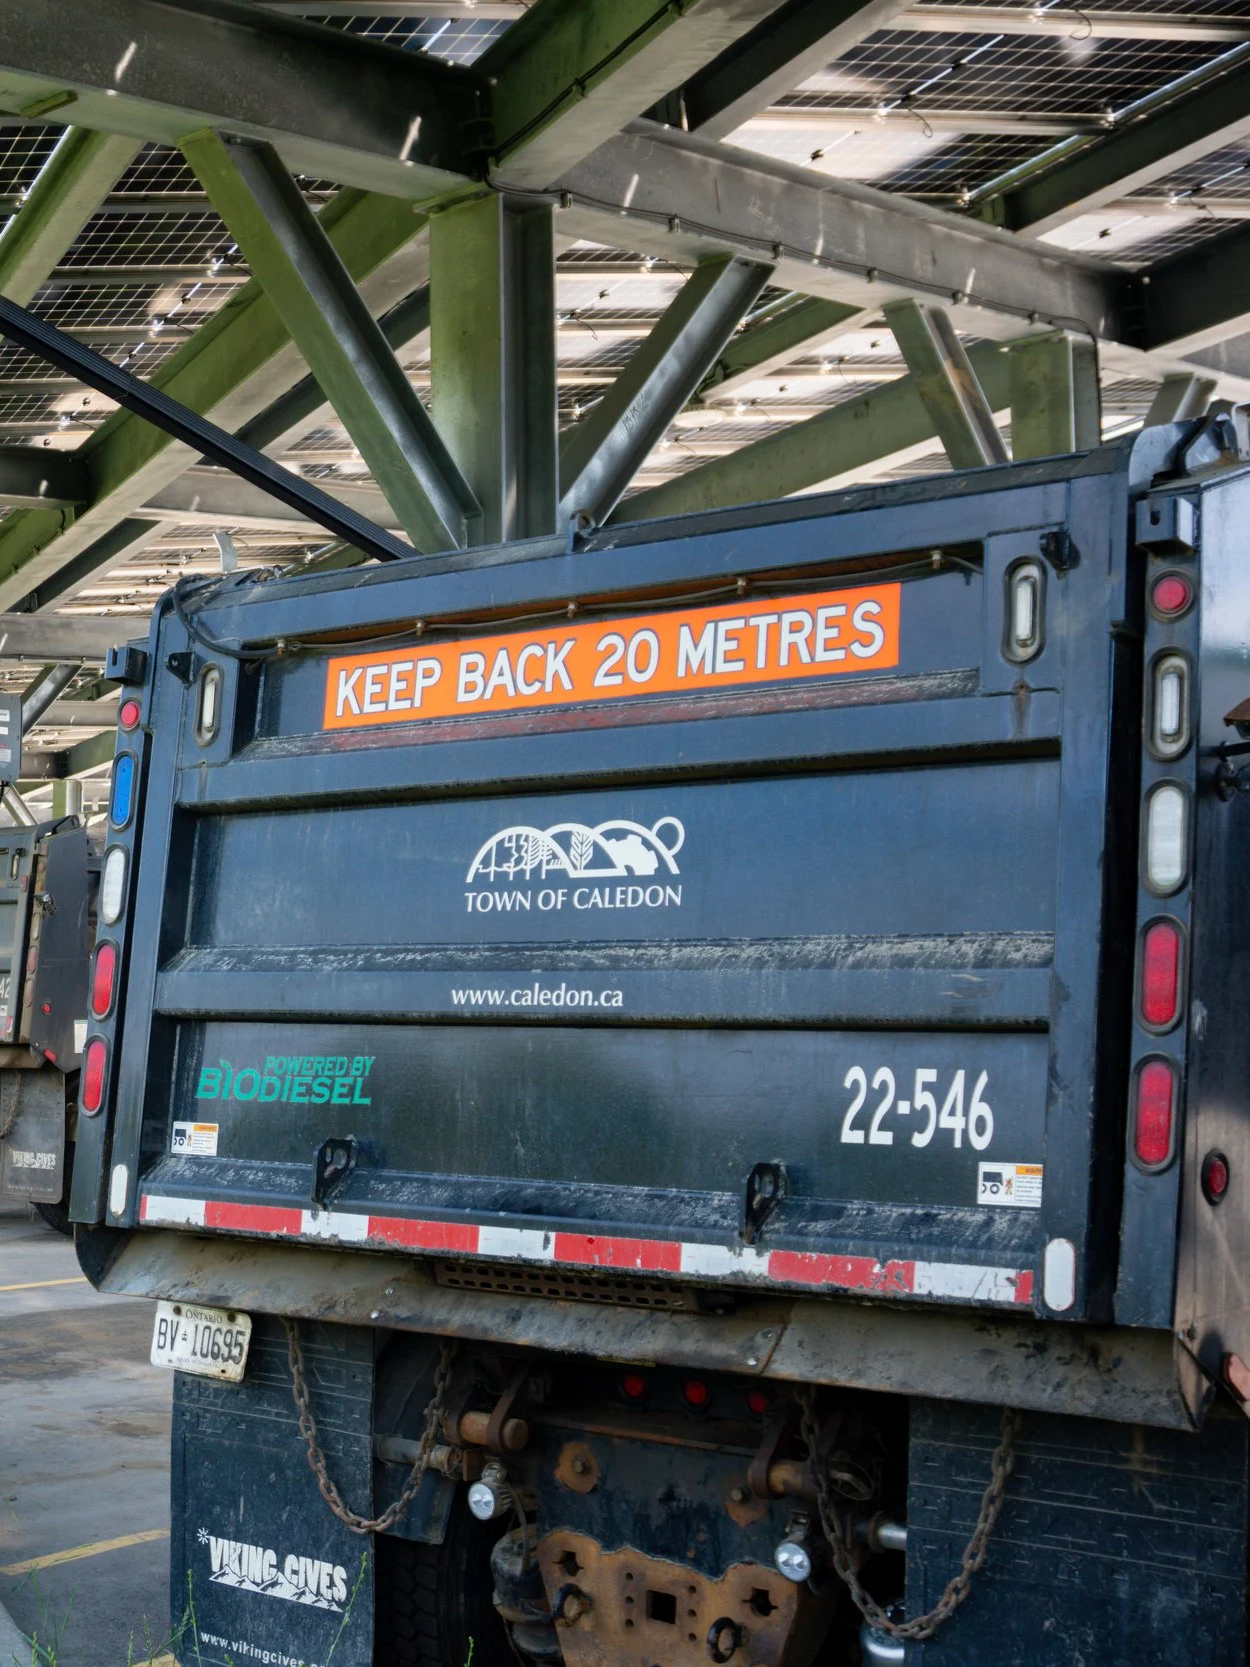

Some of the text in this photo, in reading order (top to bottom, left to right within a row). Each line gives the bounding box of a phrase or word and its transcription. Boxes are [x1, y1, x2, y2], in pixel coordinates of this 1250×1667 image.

[335, 599, 886, 718] KEEP BACK 20 METRES
[463, 884, 683, 913] TOWN OF CALEDON
[450, 982, 624, 1007] www.caledon.ca
[263, 1055, 377, 1077] POWERED BY
[840, 1065, 995, 1151] 22-546
[157, 1317, 247, 1365] BV 10695
[208, 1535, 348, 1602] VIKING CIVES
